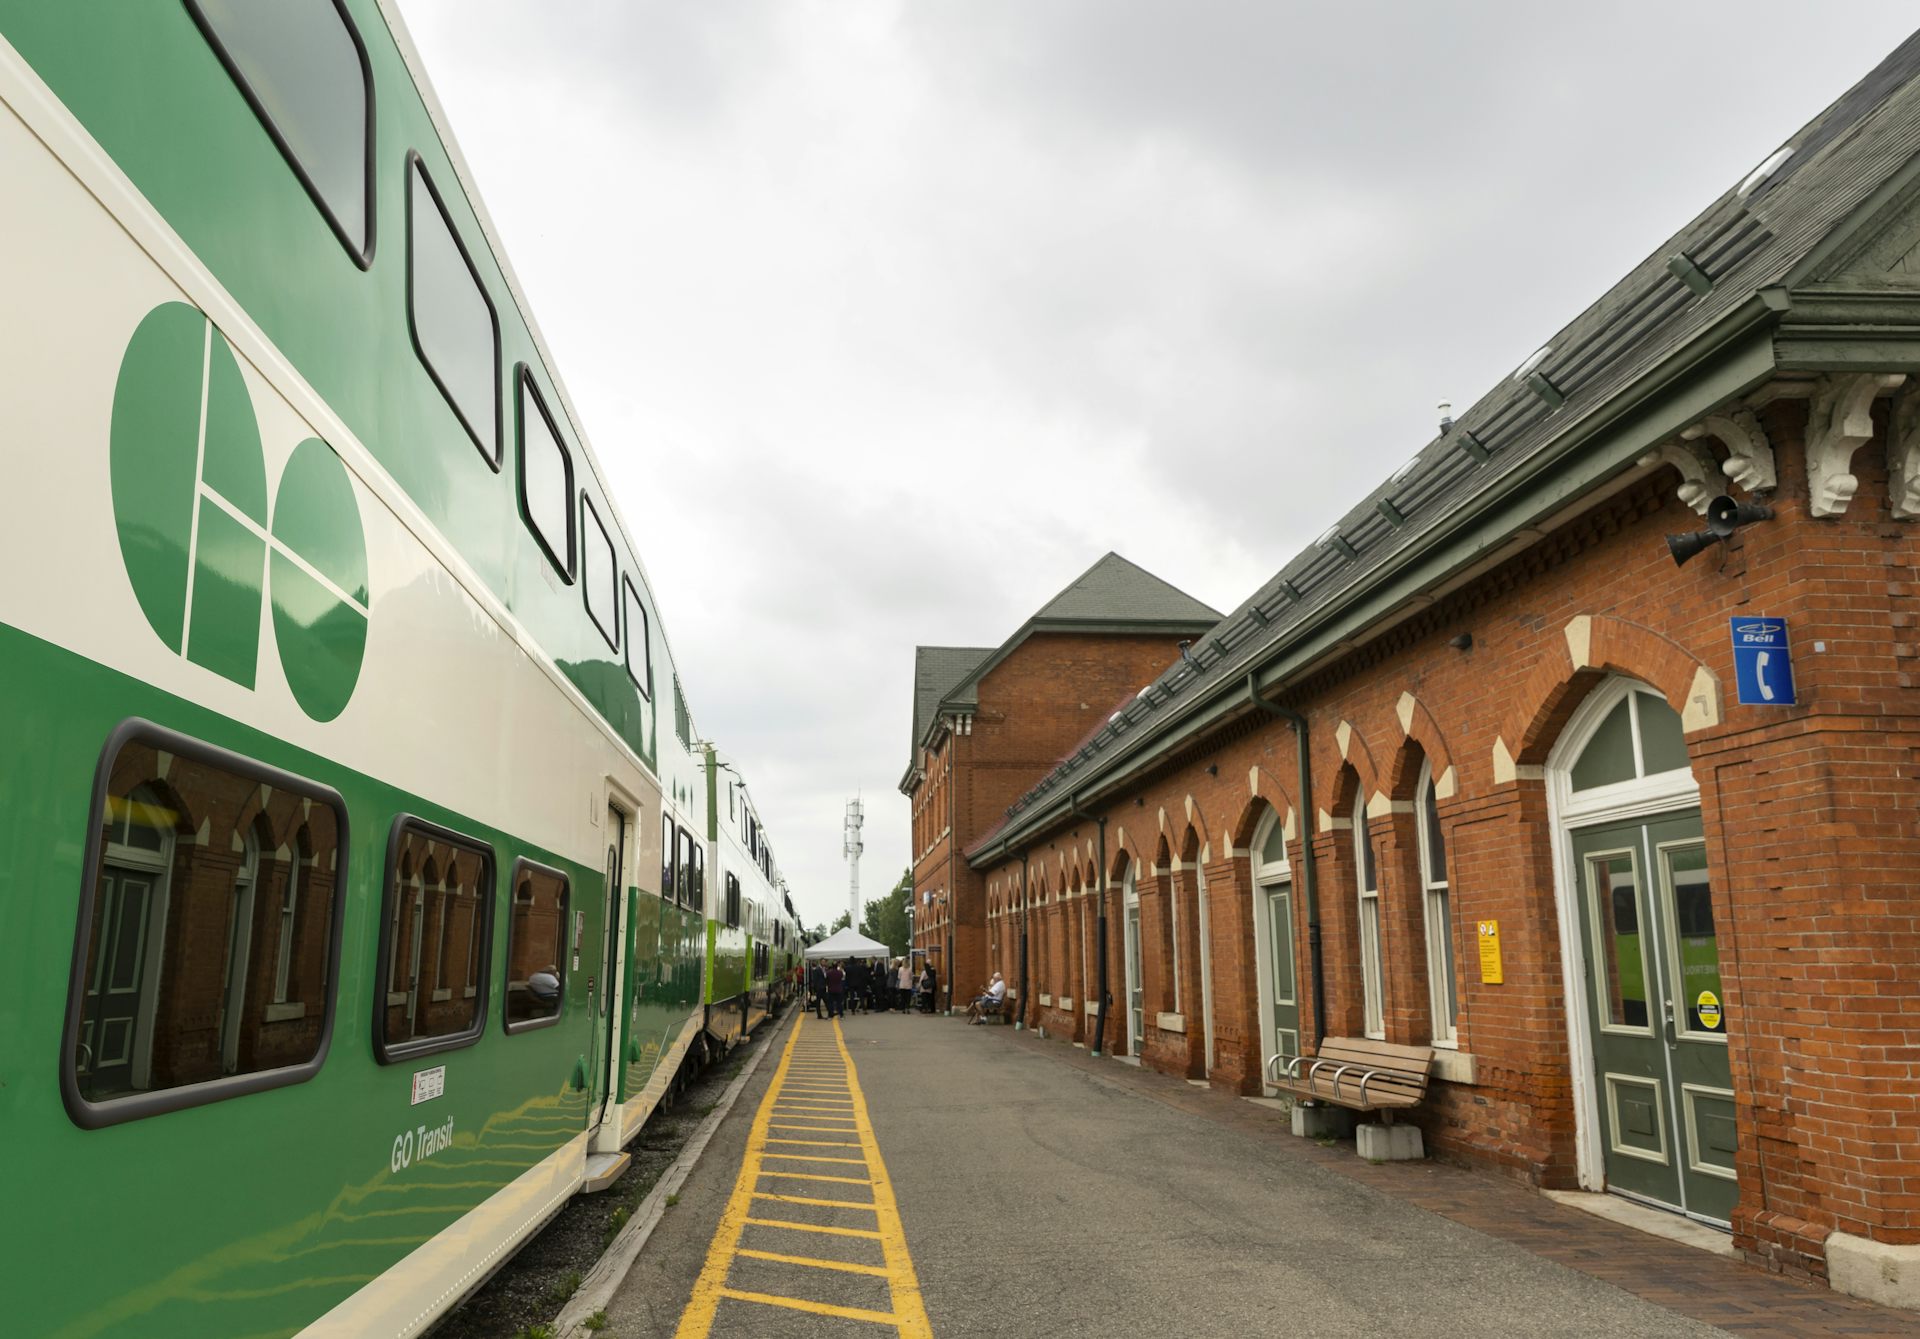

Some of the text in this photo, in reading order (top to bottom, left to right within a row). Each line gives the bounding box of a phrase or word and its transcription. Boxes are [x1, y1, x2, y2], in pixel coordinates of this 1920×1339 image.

[1743, 634, 1774, 643] Bell
[391, 1115, 454, 1173] GO Transit
